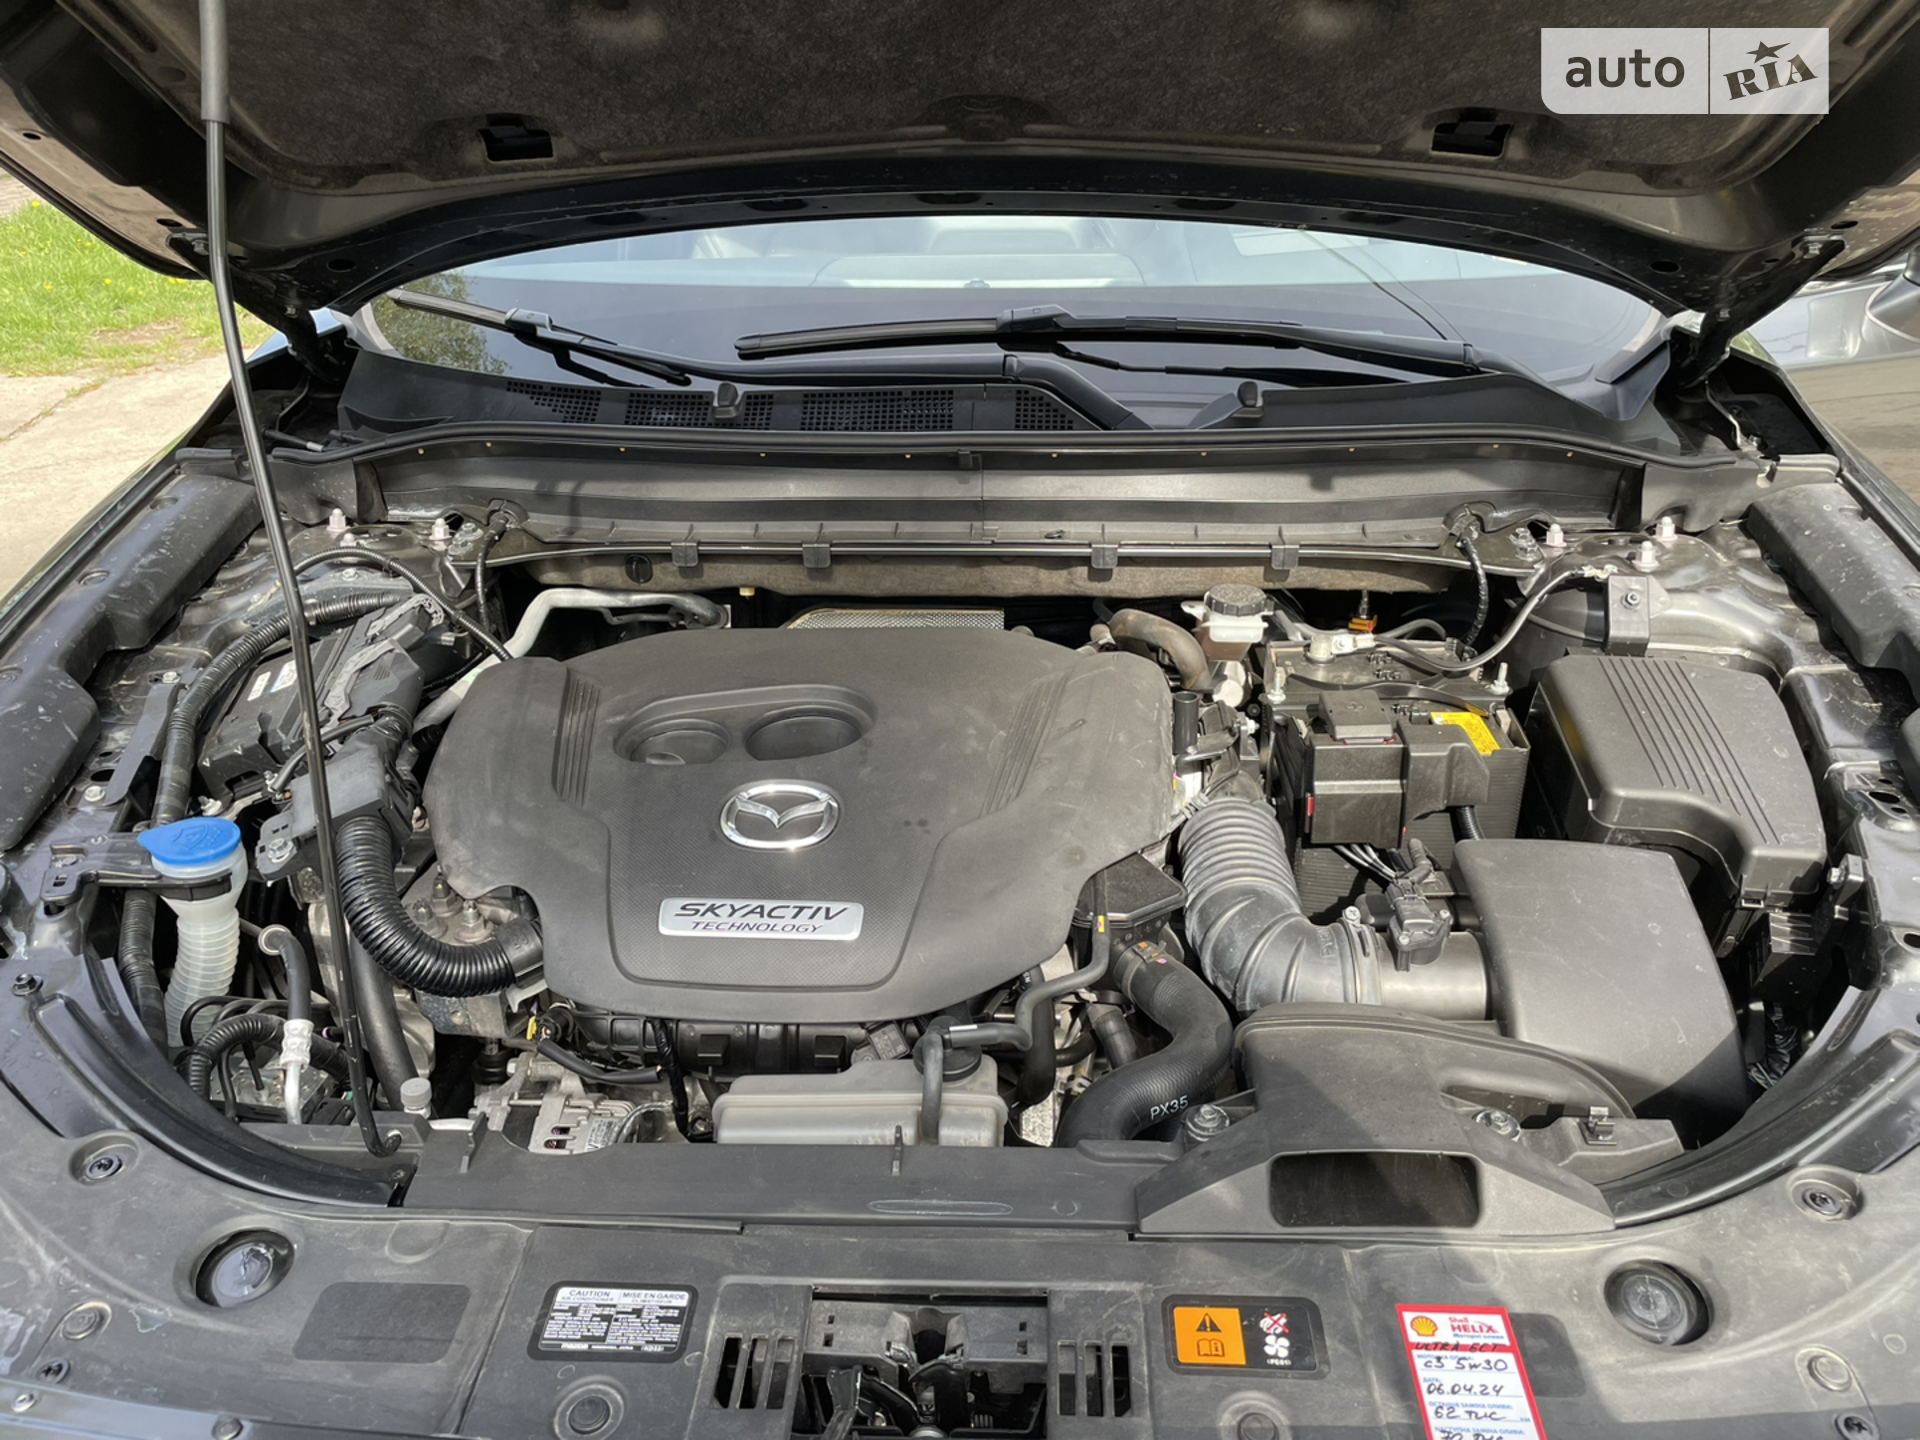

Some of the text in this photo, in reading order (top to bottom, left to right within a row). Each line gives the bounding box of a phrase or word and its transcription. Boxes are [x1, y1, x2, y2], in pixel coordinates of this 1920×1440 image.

[674, 903, 849, 920] SKYACTIV
[691, 921, 823, 933] TECHNOLOGY
[1150, 1095, 1188, 1120] PX35
[569, 1289, 611, 1297] CAUTION
[657, 1293, 686, 1301] GARDE
[1451, 1324, 1496, 1333] HELIX
[1427, 1383, 1504, 1397] 06.04.24
[1434, 1406, 1460, 1419] 62
